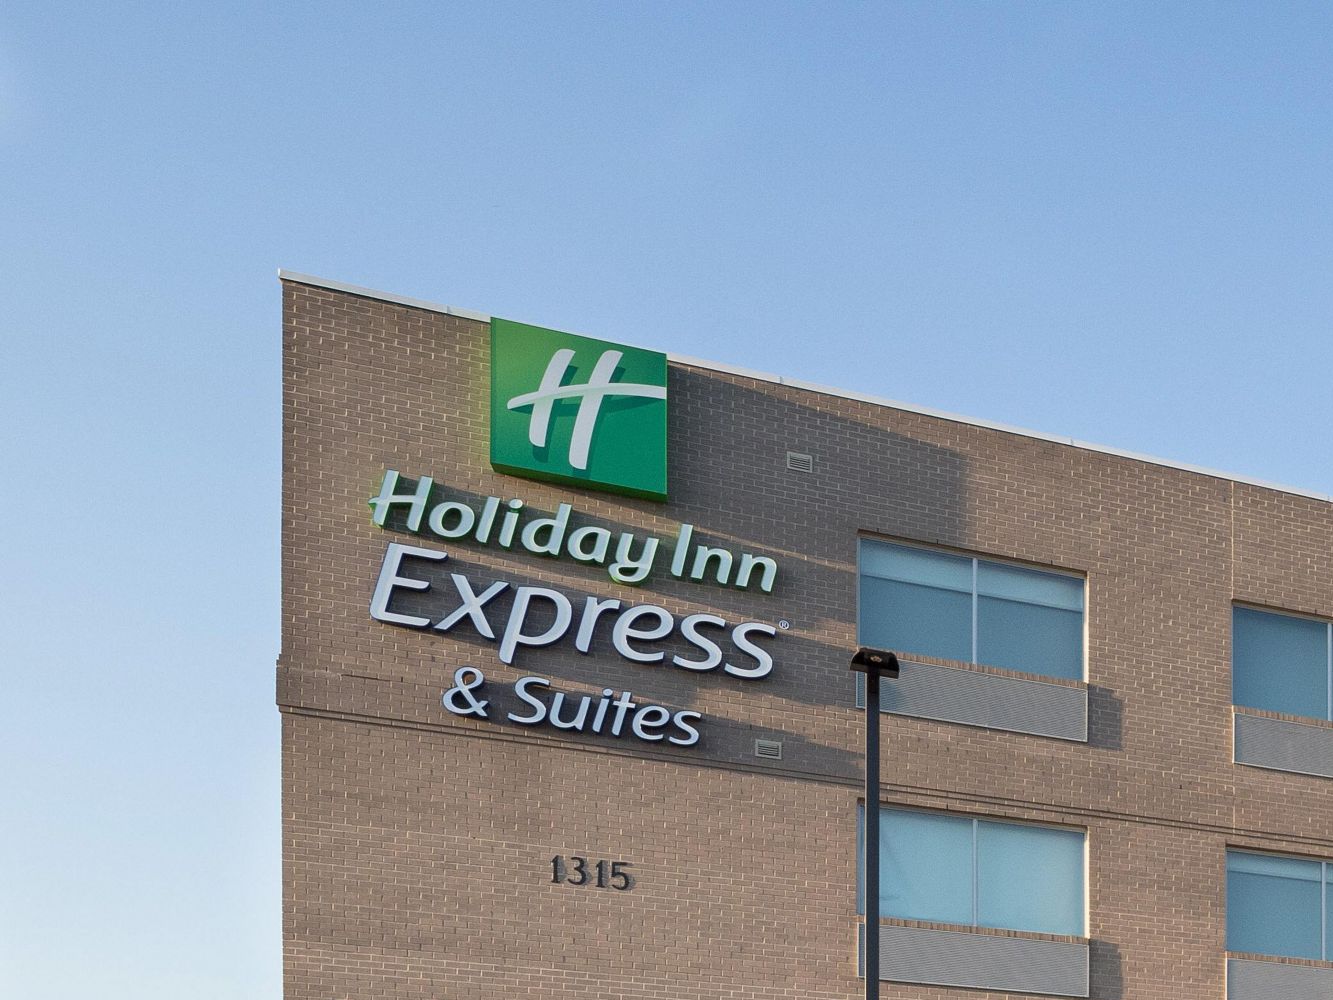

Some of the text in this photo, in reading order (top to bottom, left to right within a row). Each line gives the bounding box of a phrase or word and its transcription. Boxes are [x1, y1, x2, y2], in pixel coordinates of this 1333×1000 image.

[369, 469, 778, 593] Holiday Inn
[442, 666, 701, 747] & Suites
[551, 855, 630, 890] 1315
